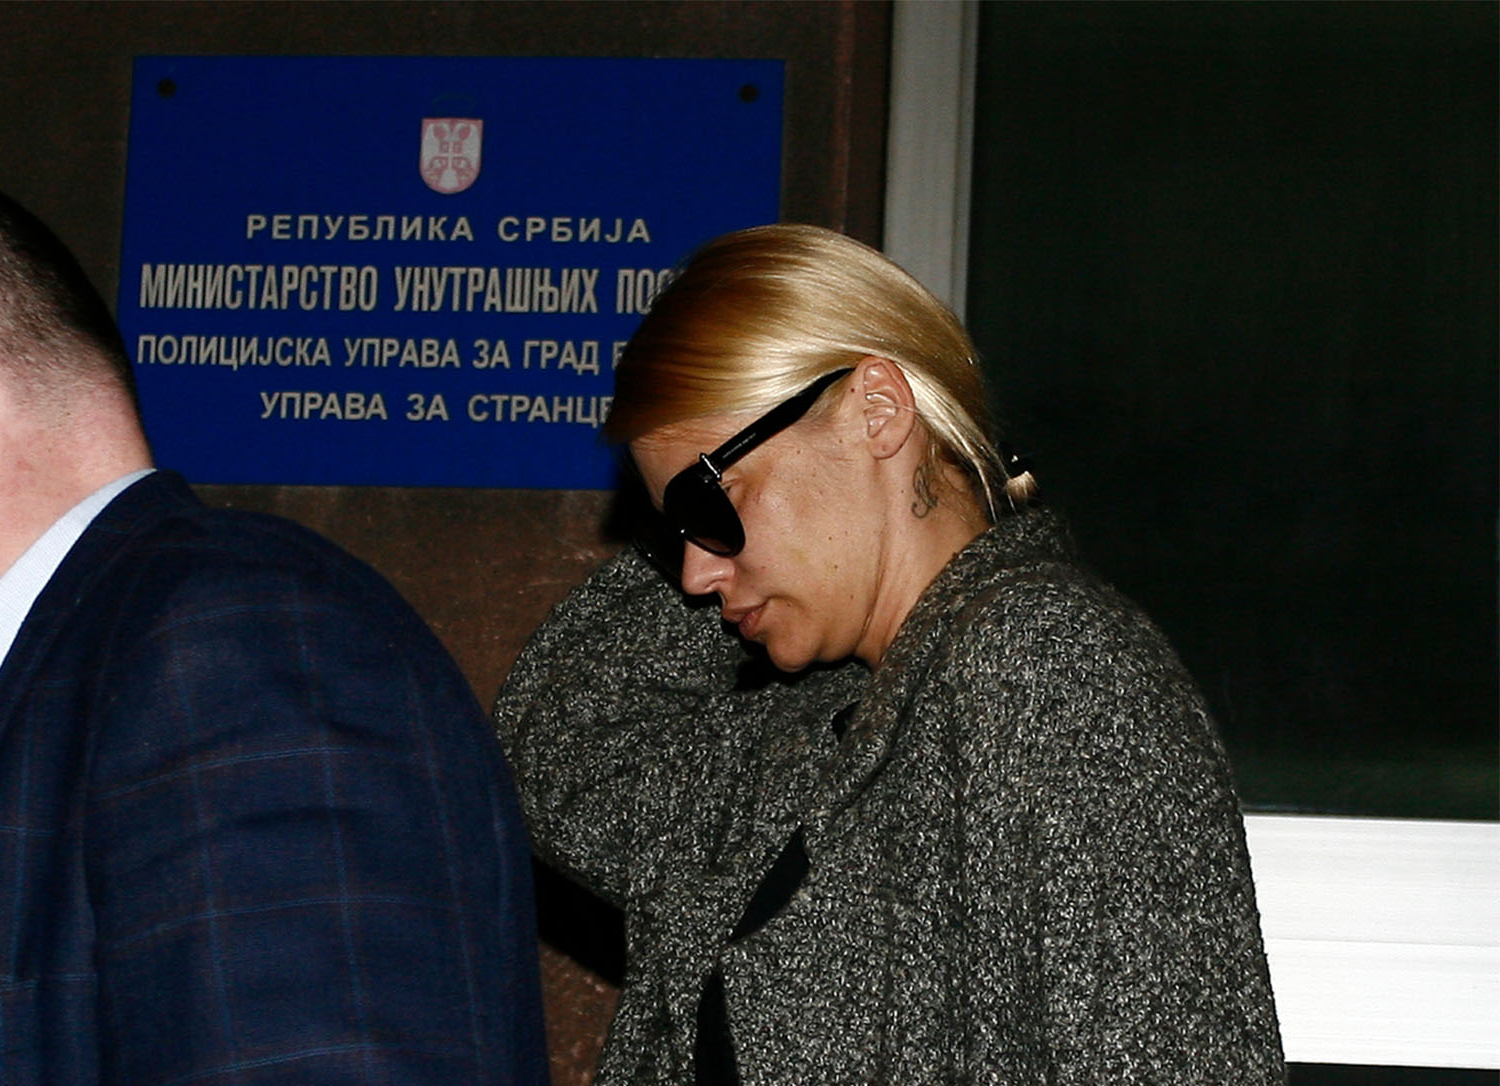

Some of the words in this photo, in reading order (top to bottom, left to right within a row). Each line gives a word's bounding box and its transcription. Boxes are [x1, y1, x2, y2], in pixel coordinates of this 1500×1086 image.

[246, 214, 475, 242] РЕПУБЛИКА
[497, 216, 651, 243] СРБИЈА
[139, 263, 378, 312] МИНИСТАРСТВО
[394, 266, 599, 314] УНУТРАШЊИХ
[137, 335, 331, 371] ПОЛИЦИЈСКА
[344, 338, 461, 368] УПРАВА
[472, 340, 511, 369] ЗА
[522, 341, 600, 376] ГРАД
[260, 392, 388, 421] УПРАВА
[406, 393, 450, 422] ЗА
